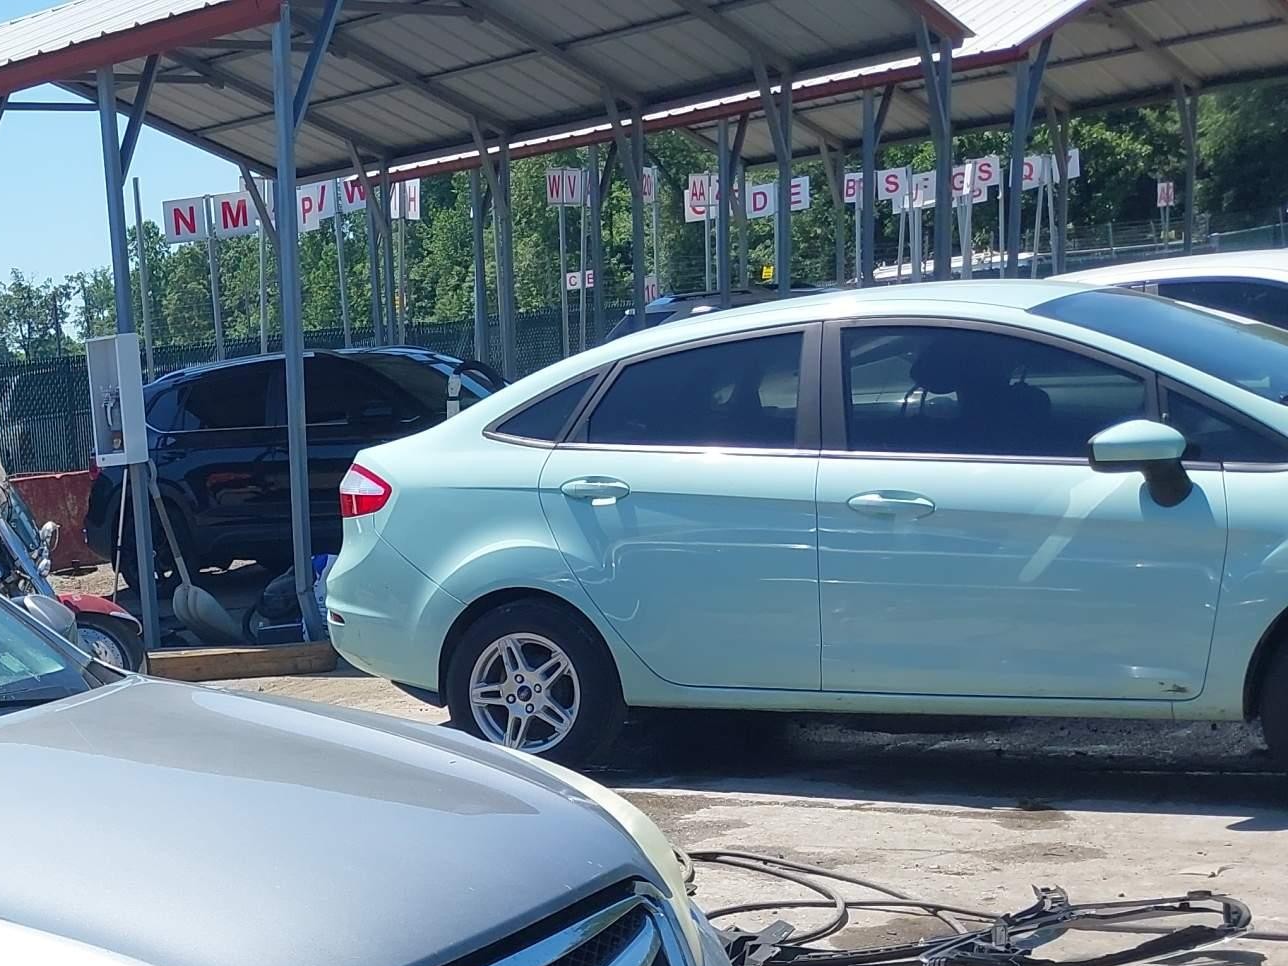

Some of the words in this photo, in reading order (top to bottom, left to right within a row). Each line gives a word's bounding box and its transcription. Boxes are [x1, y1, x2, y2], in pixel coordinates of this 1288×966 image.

[977, 162, 993, 182] S
[548, 175, 561, 199] W
[567, 175, 577, 199] V
[692, 180, 706, 201] AA
[845, 179, 856, 198] B
[885, 174, 900, 194] S
[301, 196, 313, 225] P
[408, 186, 417, 213] H
[752, 191, 768, 212] D
[173, 206, 197, 236] N
[221, 199, 249, 230] M
